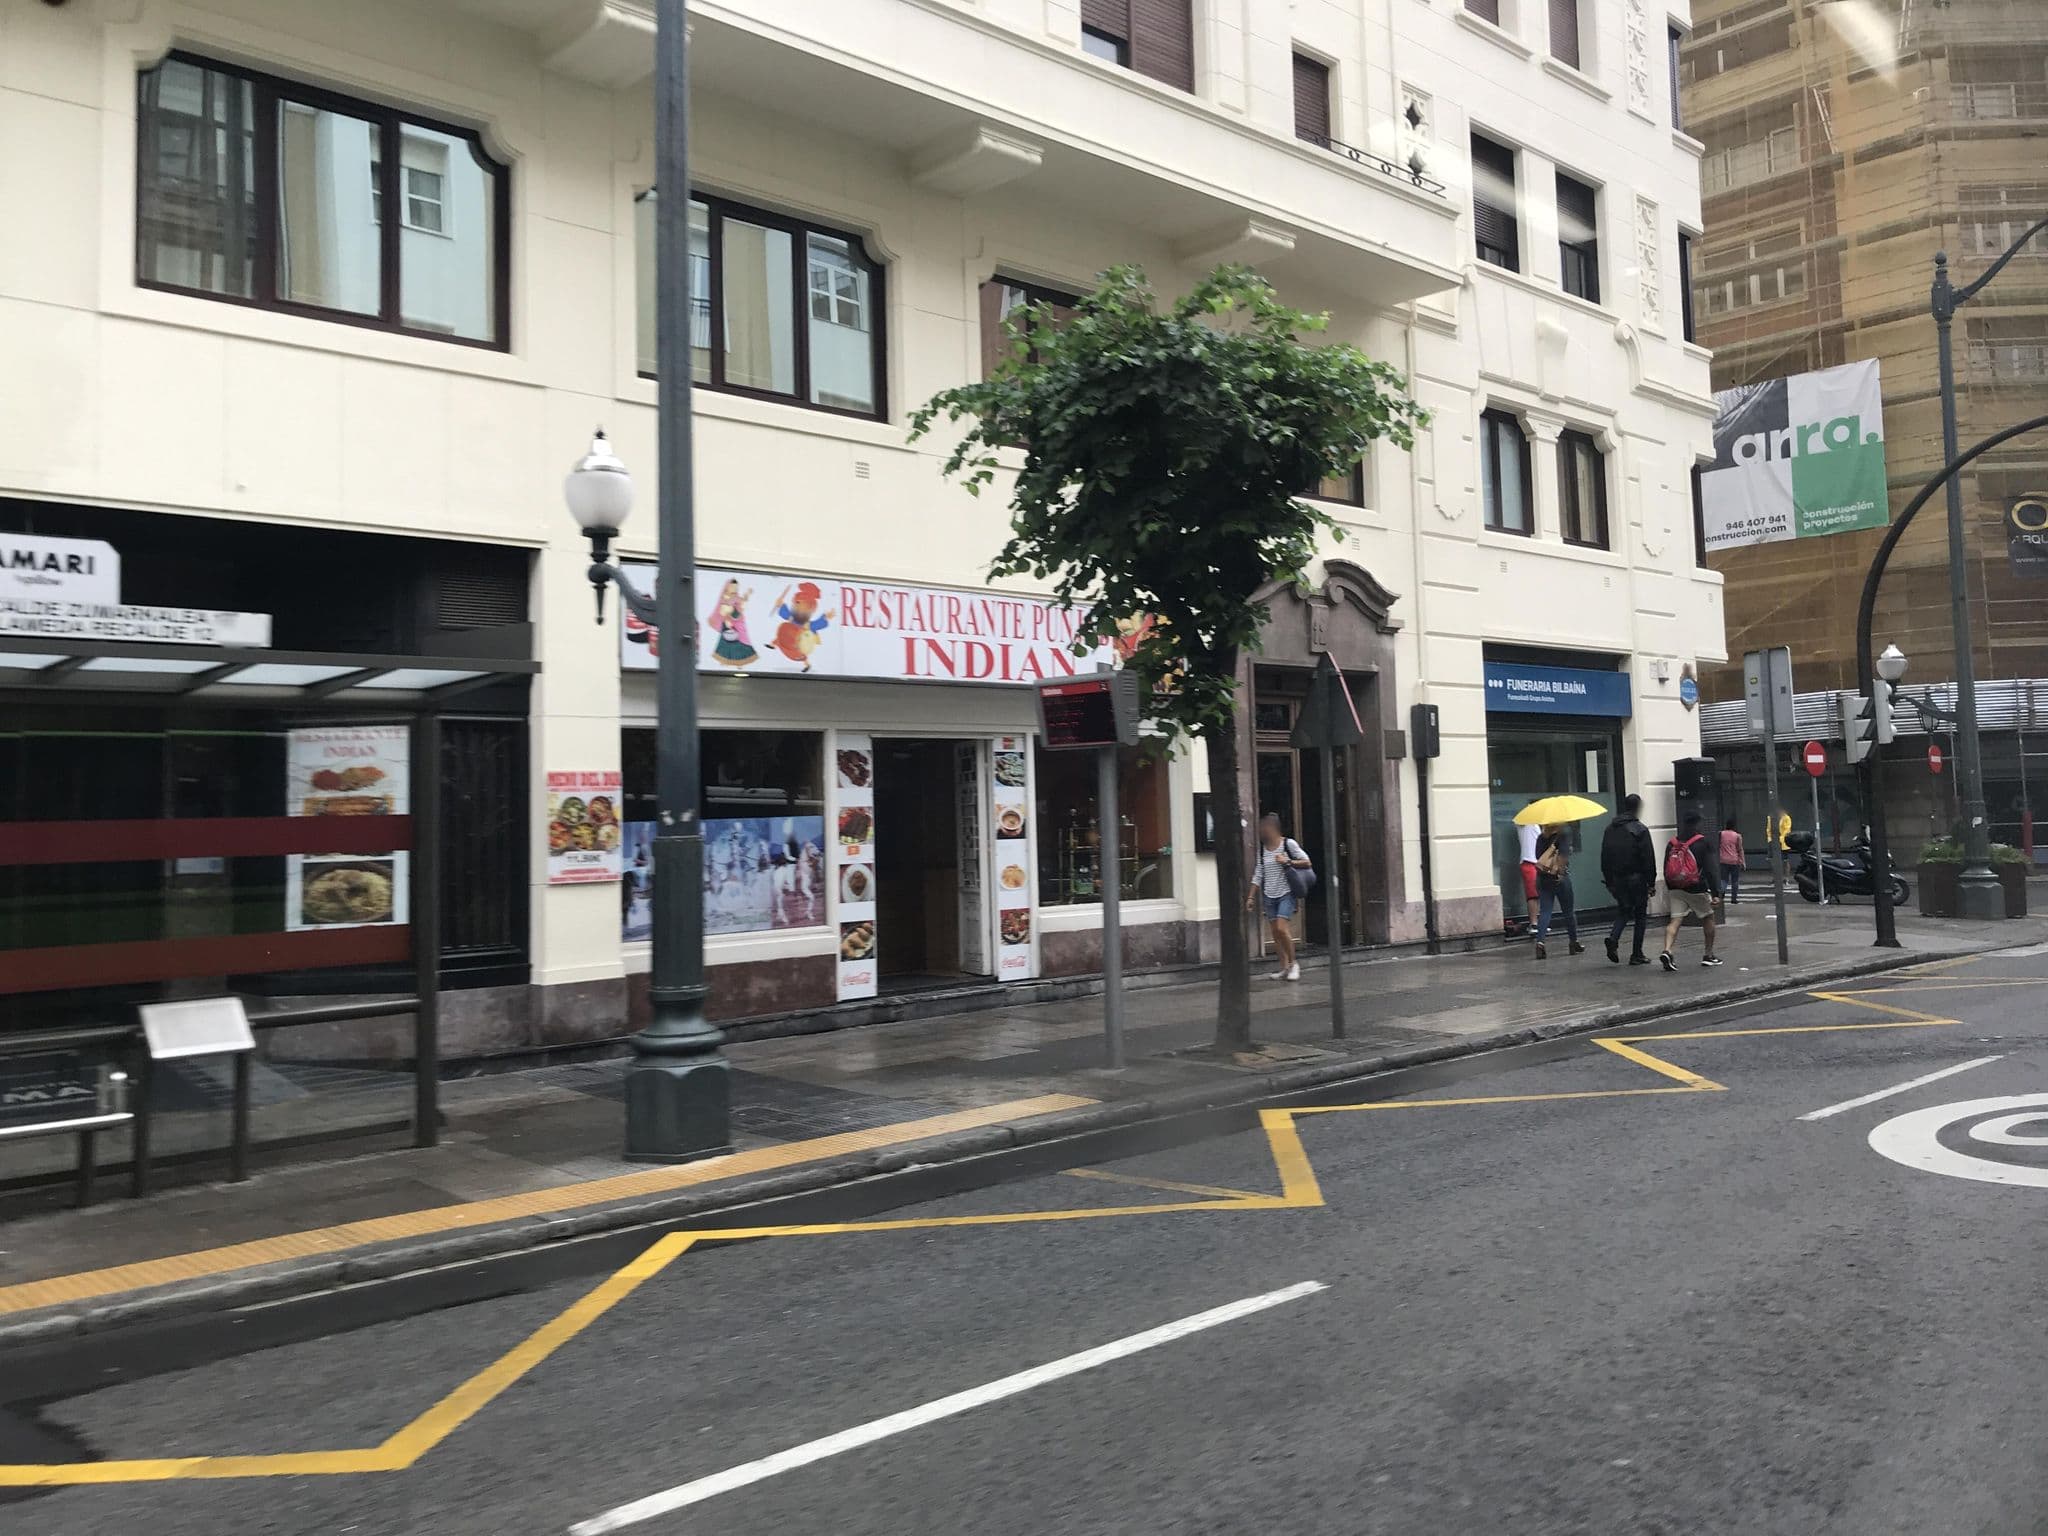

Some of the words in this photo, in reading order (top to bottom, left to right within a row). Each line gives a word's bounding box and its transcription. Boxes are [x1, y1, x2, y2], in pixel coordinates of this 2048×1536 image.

[1803, 500, 1874, 519] construcción
[1726, 520, 1744, 531] 946
[1747, 516, 1765, 527] 407
[1768, 514, 1786, 524] 941
[1803, 514, 1858, 530] proyectos
[840, 586, 1025, 640] RESTAURANTE
[901, 637, 1077, 679] INDIAN
[1506, 678, 1552, 693] FUNERARIA
[1552, 680, 1587, 695] BILBAÍNA
